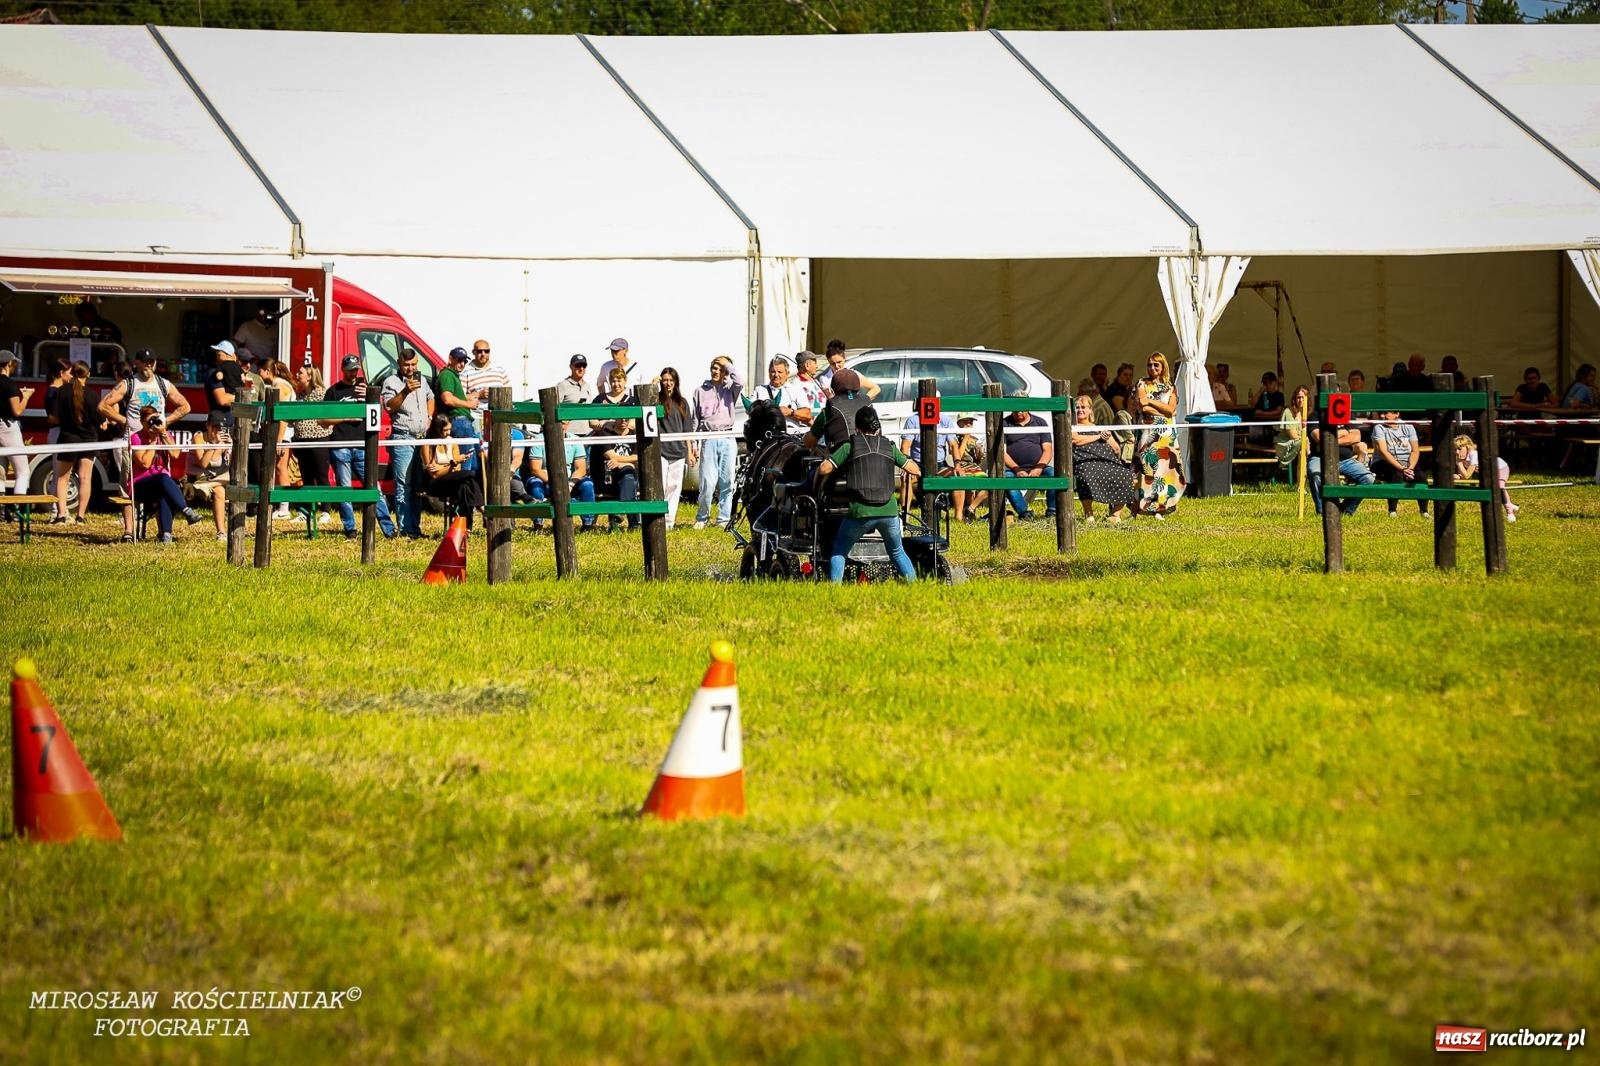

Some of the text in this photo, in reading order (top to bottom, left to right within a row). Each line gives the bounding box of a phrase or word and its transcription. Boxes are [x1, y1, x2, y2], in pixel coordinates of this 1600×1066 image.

[370, 409, 378, 427] B
[923, 402, 936, 419] B
[1332, 399, 1346, 419] C
[646, 411, 655, 432] C
[711, 704, 732, 752] 7
[31, 725, 56, 775] 7
